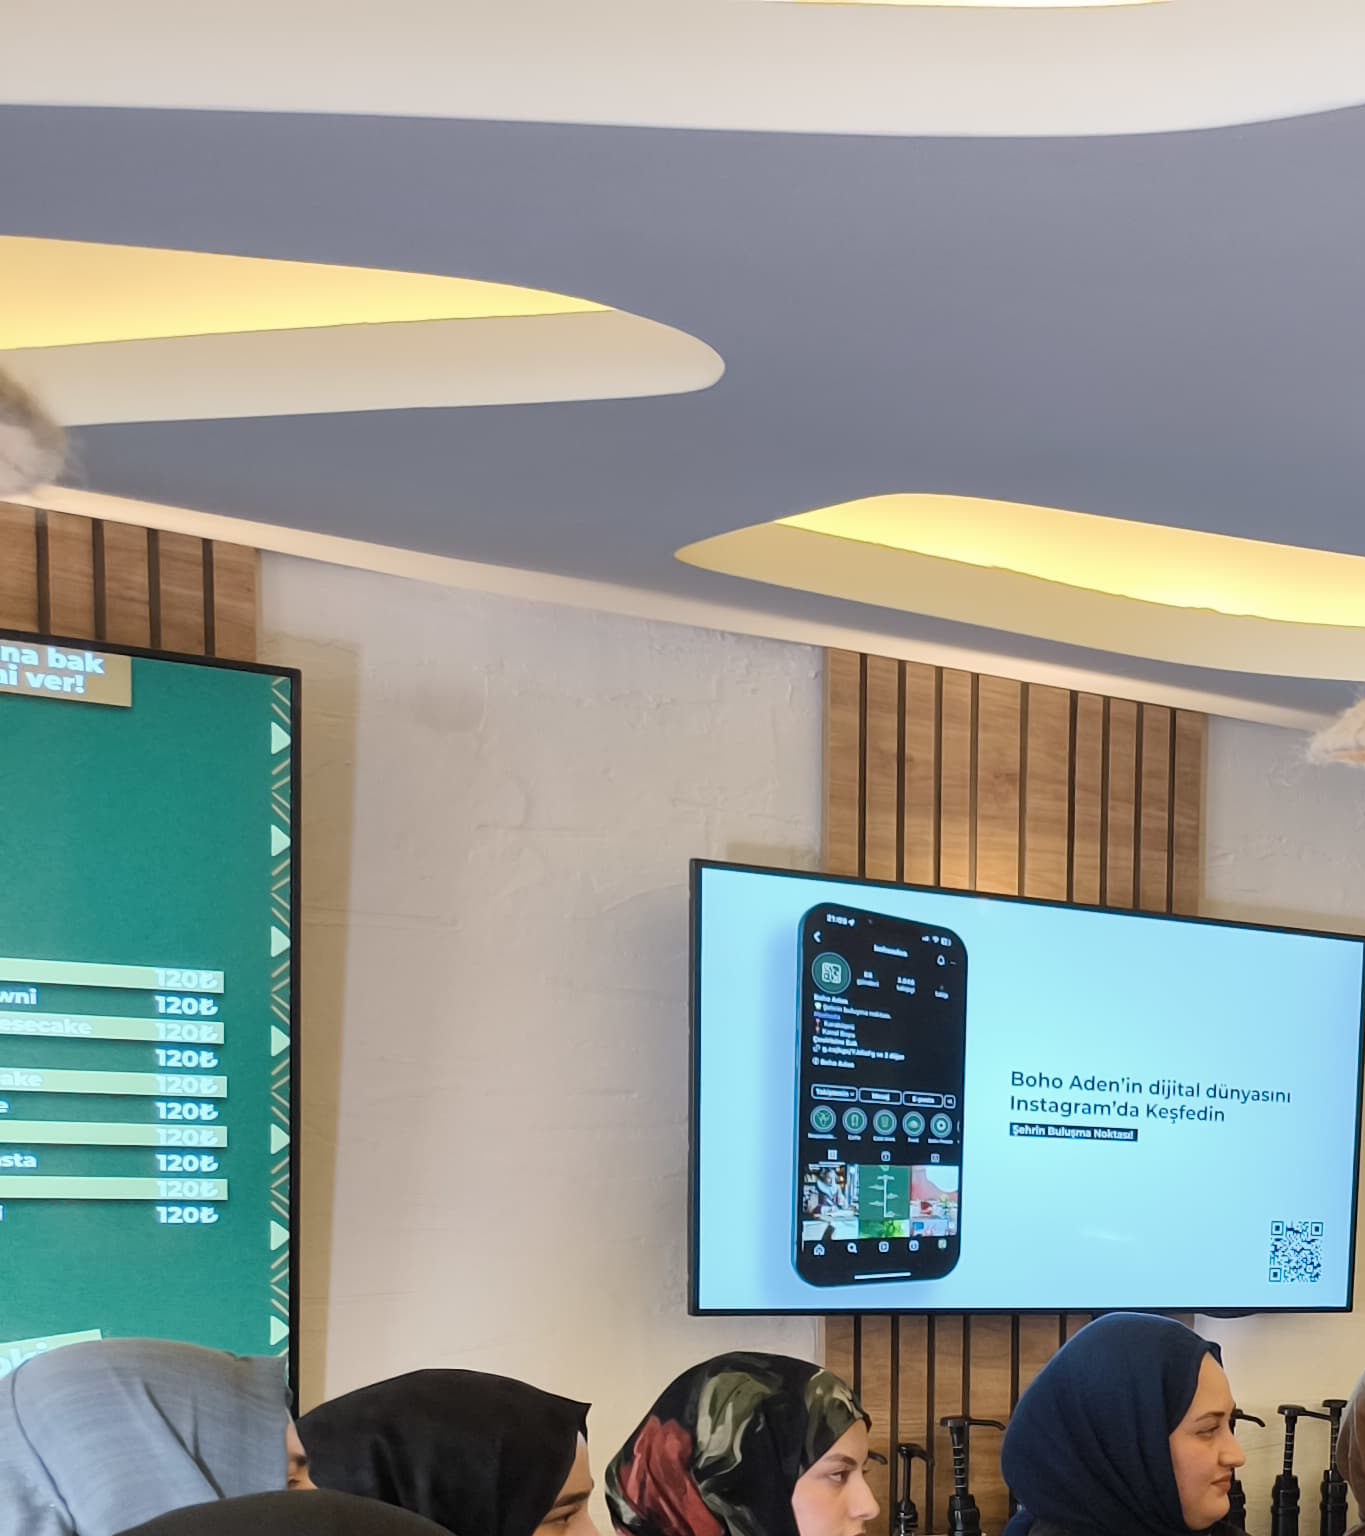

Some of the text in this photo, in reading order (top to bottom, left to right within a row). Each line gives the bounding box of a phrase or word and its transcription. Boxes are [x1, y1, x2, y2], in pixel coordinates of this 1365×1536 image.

[47, 646, 104, 674] bak
[25, 671, 85, 694] ver!
[1011, 1071, 1291, 1104] Boho Aden'in dijital dünyasını
[1011, 1096, 1225, 1124] Instagram'da Keşfedin
[0, 1153, 37, 1168] sta
